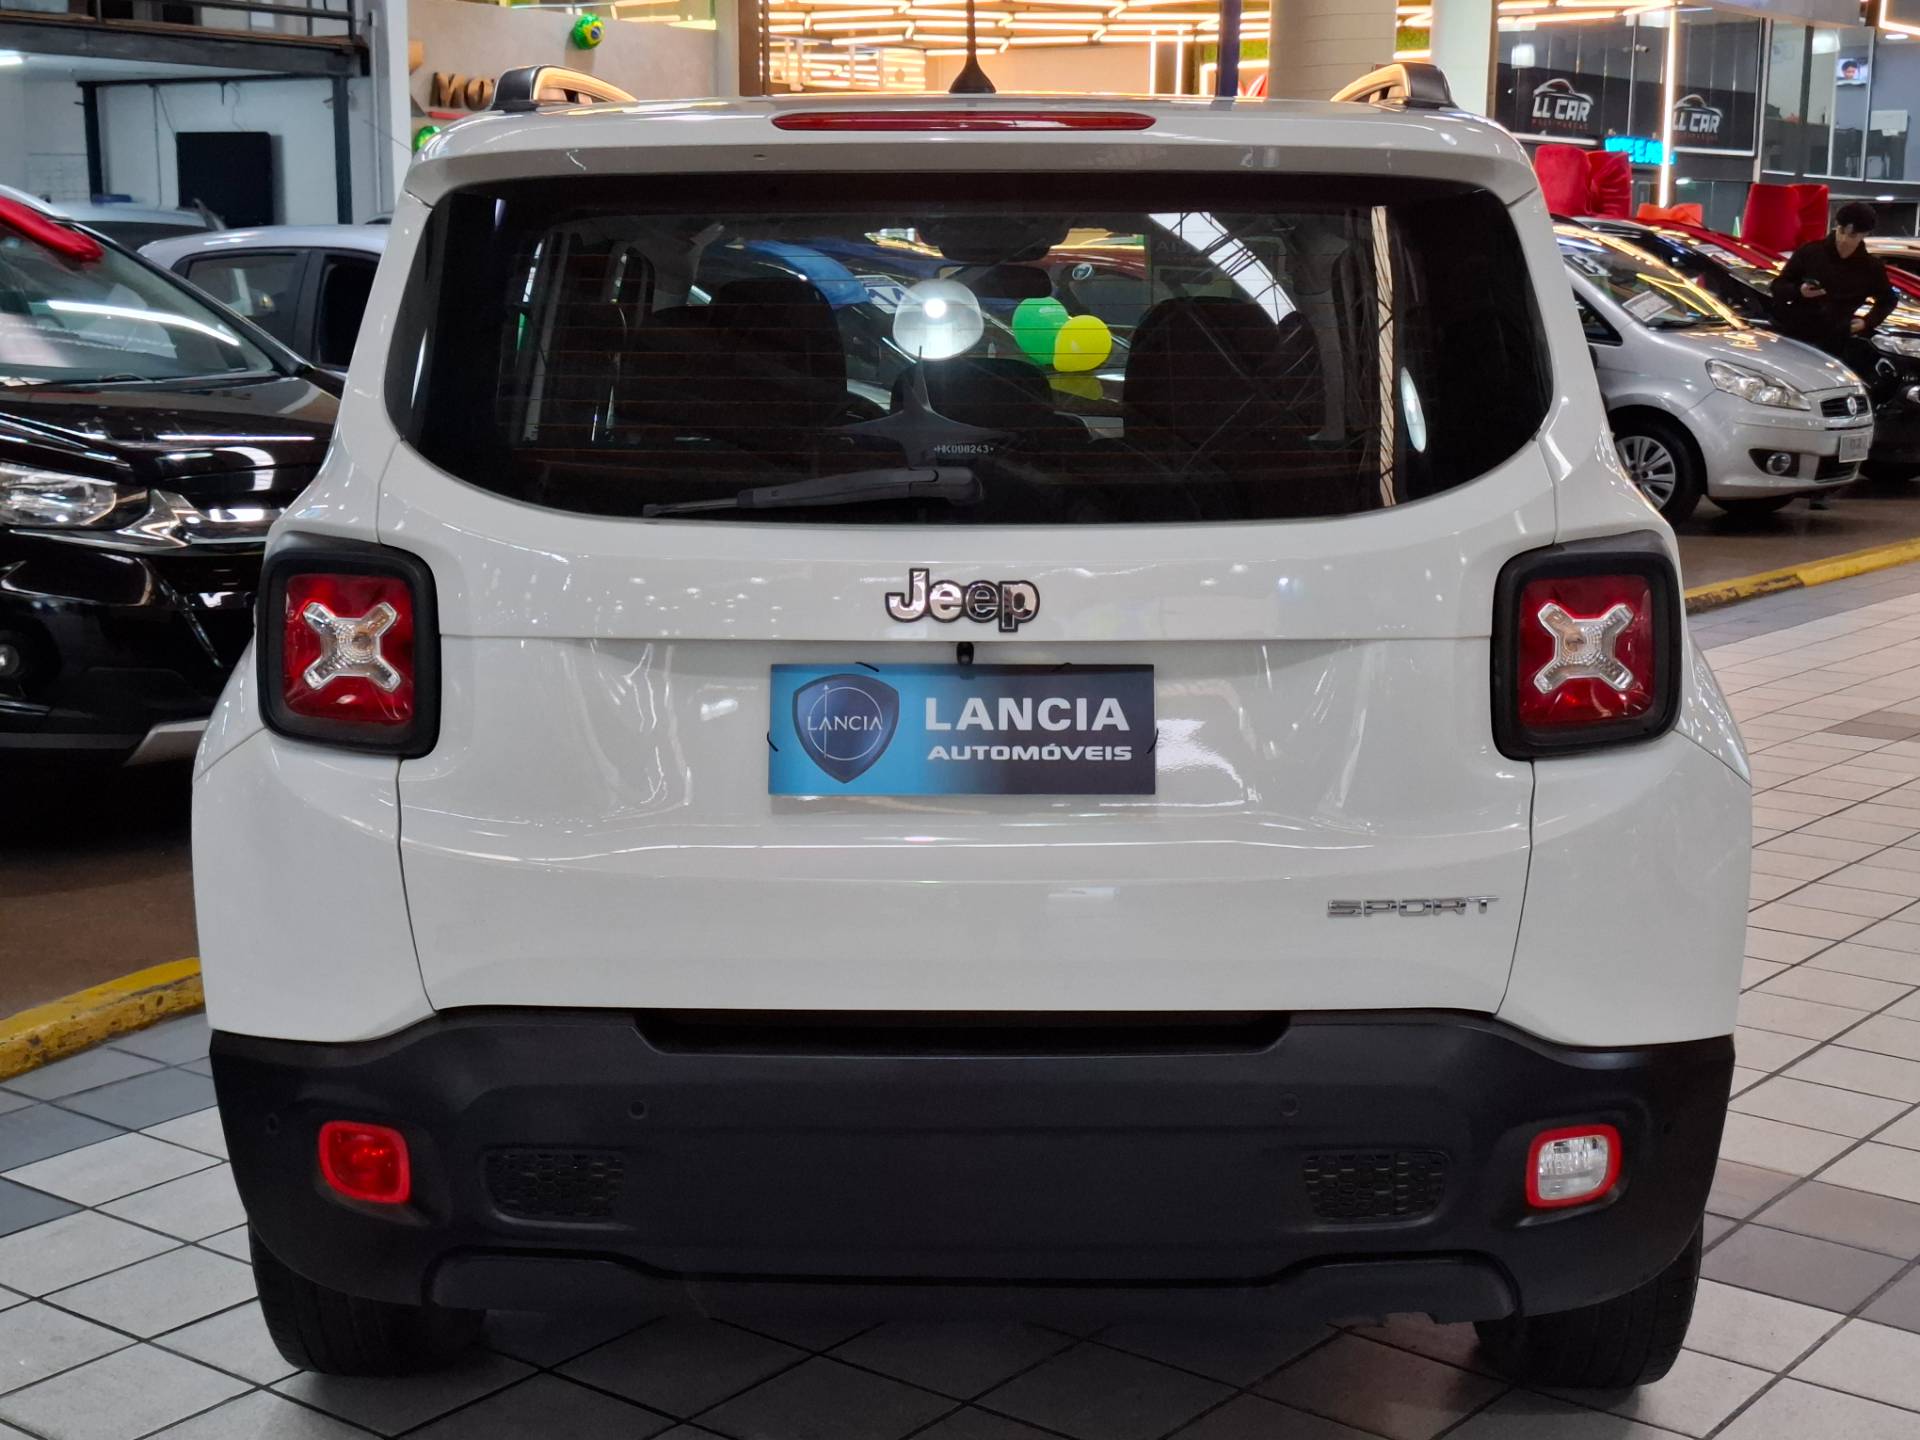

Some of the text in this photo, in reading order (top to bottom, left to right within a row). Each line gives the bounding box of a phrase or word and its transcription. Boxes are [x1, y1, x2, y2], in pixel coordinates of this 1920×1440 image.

[1532, 97, 1590, 122] LL CAR
[1690, 113, 1720, 133] CAR
[885, 568, 1040, 632] Jeep
[807, 715, 882, 732] LANCIA
[925, 697, 1131, 732] LANCIA
[927, 743, 1132, 761] AUTOMÓVEIS
[1328, 896, 1499, 917] SPORT
